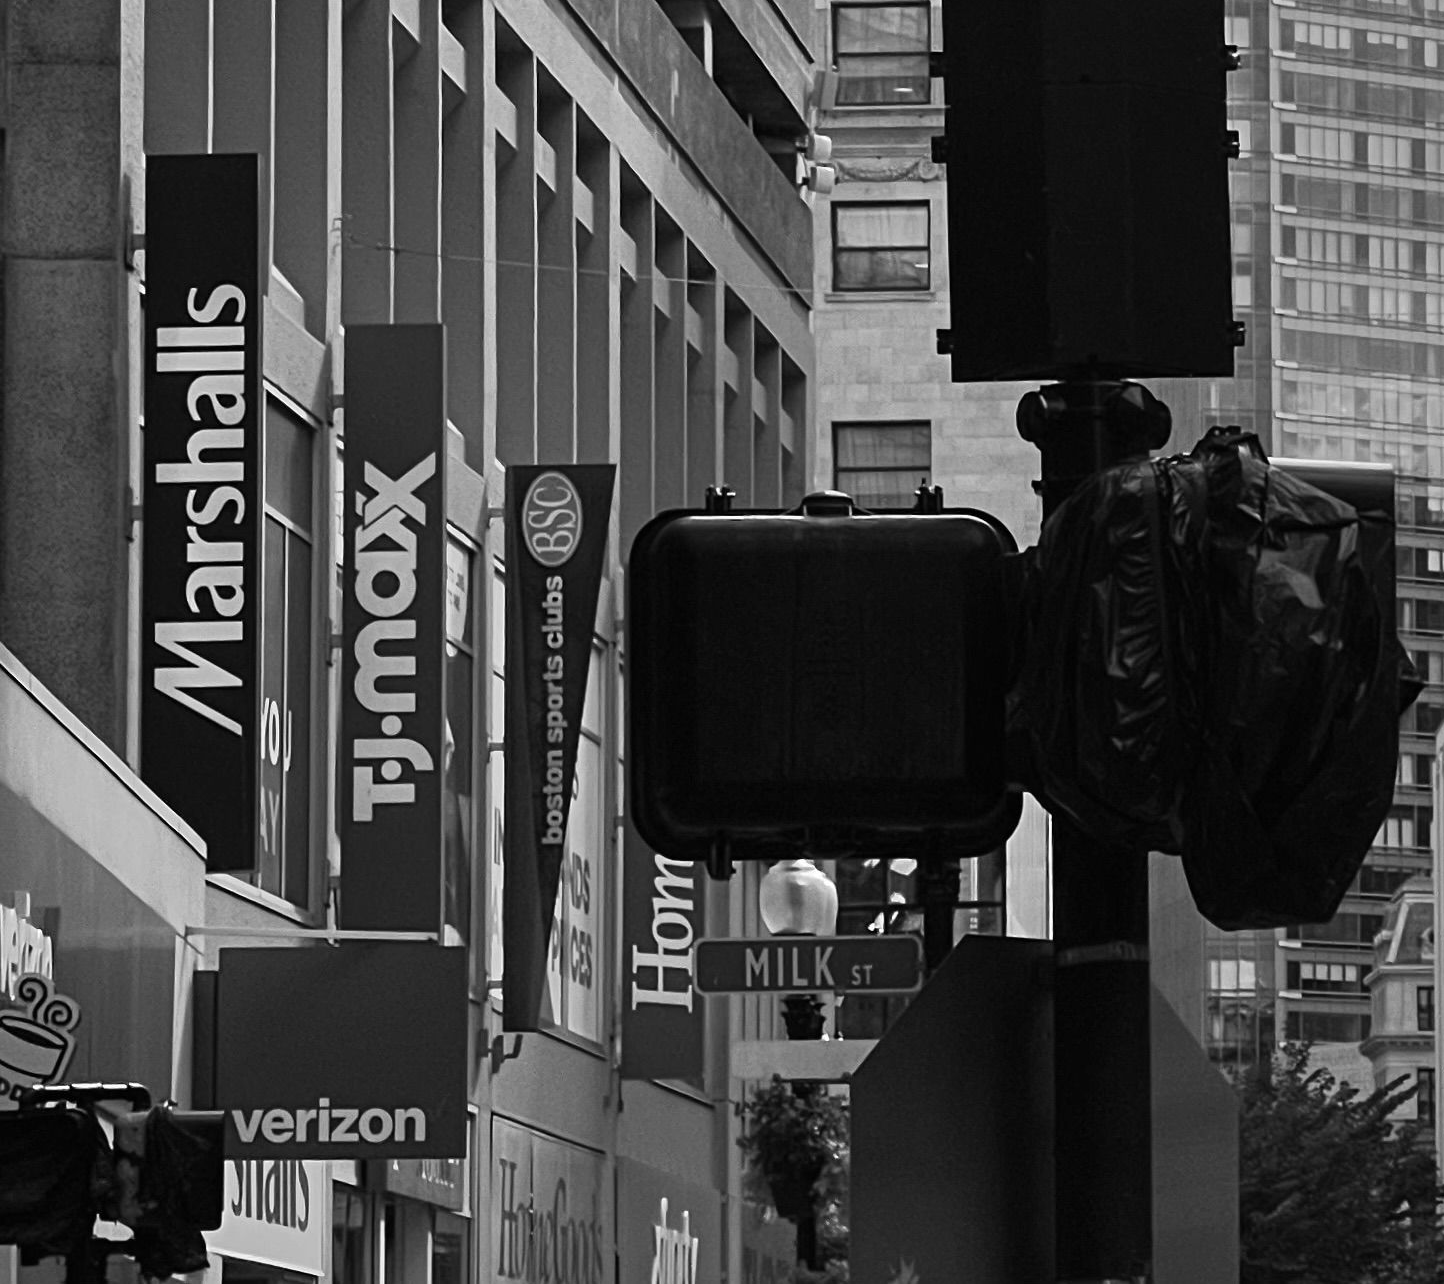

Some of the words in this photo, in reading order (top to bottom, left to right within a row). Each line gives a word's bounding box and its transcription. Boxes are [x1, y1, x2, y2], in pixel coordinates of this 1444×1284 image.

[153, 284, 247, 736] Marshalls
[528, 485, 577, 555] BSC
[541, 575, 564, 650] clubs
[542, 654, 569, 744] sports
[541, 749, 564, 845] boston
[745, 946, 835, 987] MILK
[850, 964, 874, 987] ST
[231, 1097, 426, 1143] verizon
